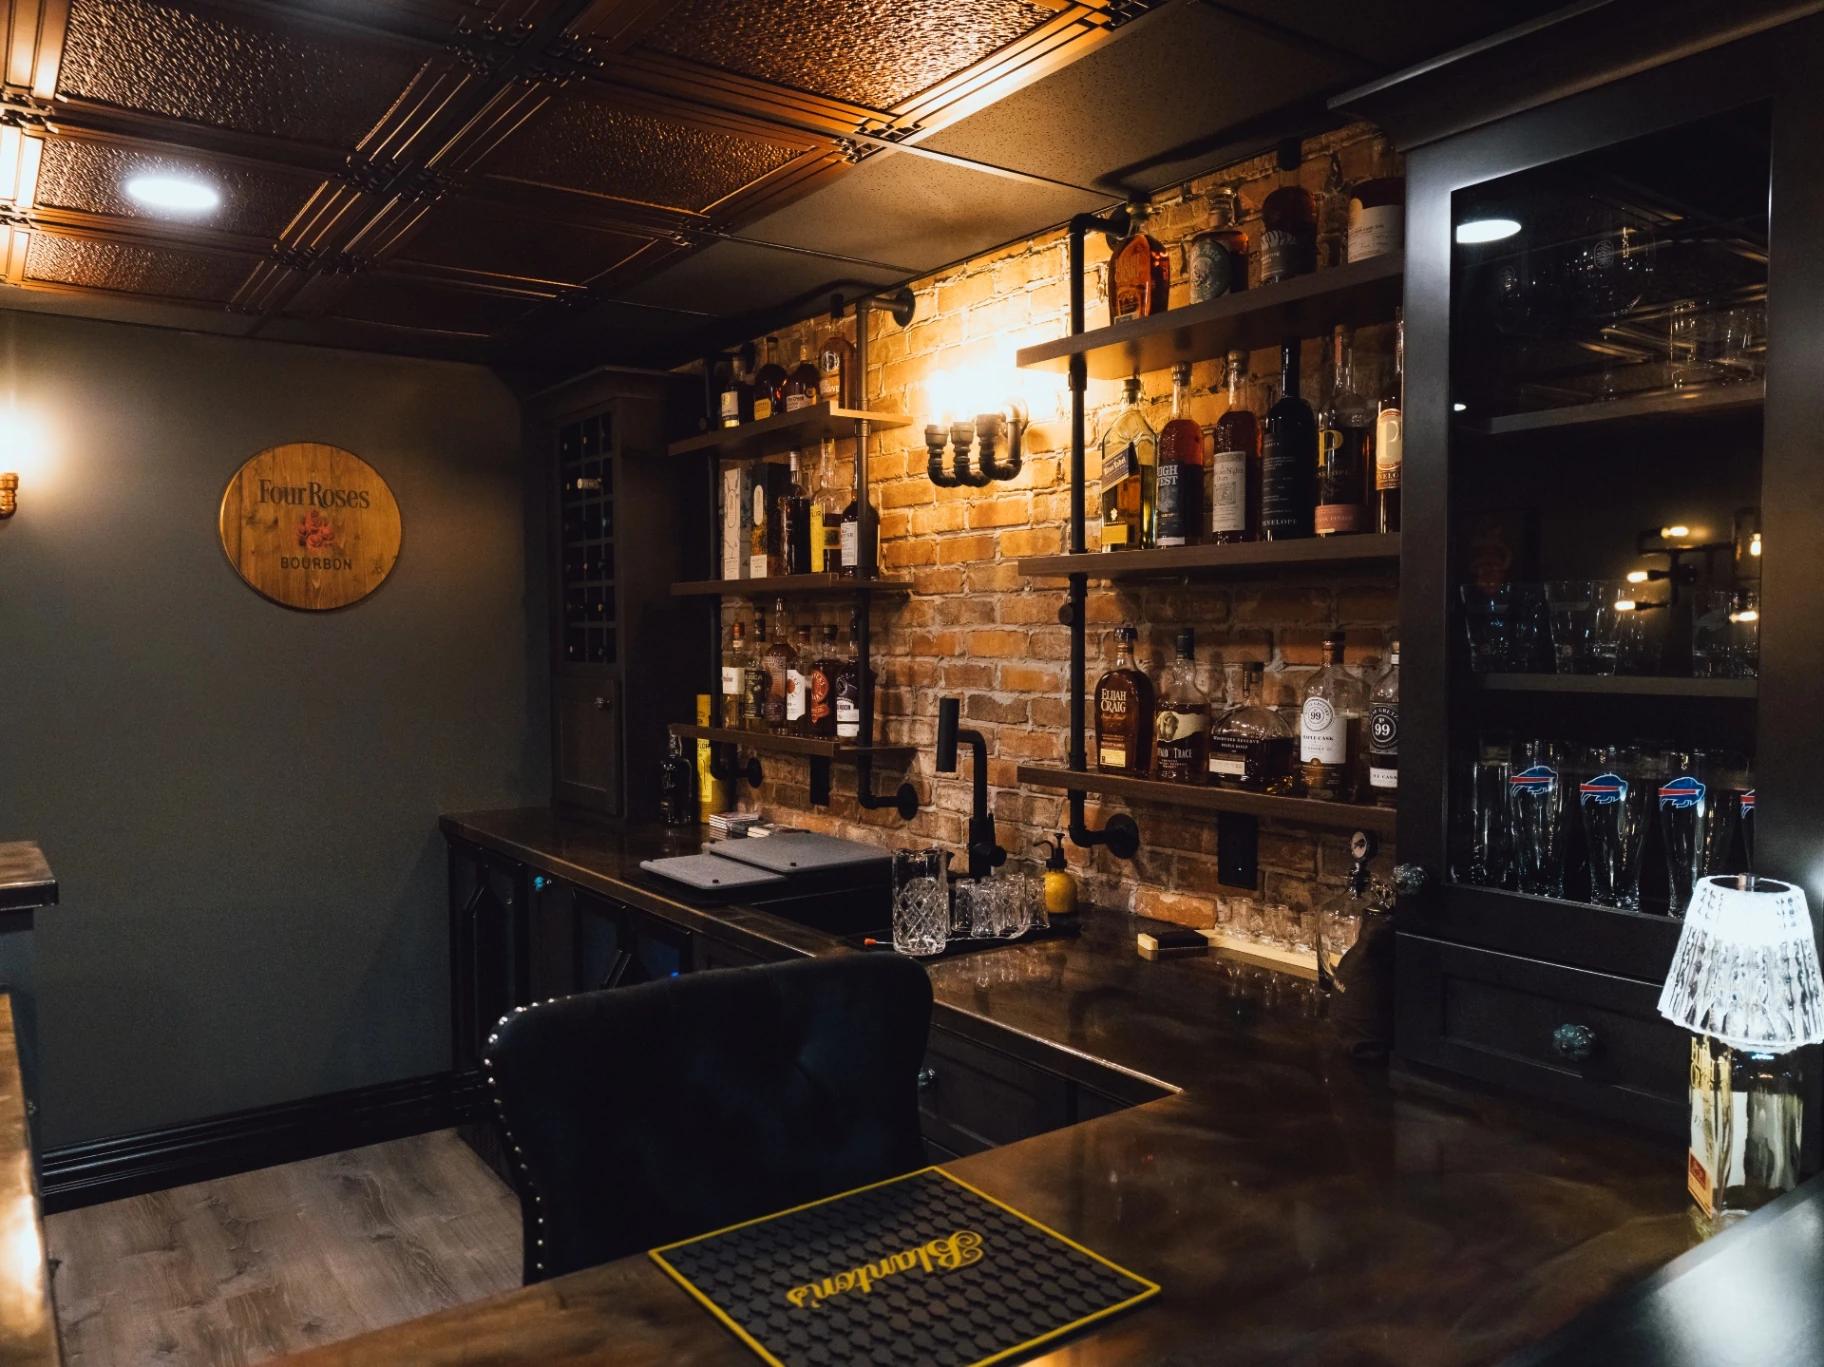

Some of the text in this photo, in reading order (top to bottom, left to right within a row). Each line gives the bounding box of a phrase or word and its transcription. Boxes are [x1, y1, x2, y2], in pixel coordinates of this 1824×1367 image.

[1317, 429, 1344, 467] P
[259, 479, 370, 509] Four Roses
[280, 556, 353, 571] BOURBON
[1101, 688, 1127, 702] ELIJAH
[1100, 699, 1127, 714] CRAIG
[1310, 711, 1322, 721] 99
[1374, 723, 1391, 737] 99
[1174, 747, 1192, 759] TRACE
[786, 1230, 984, 1309] Blanton's
